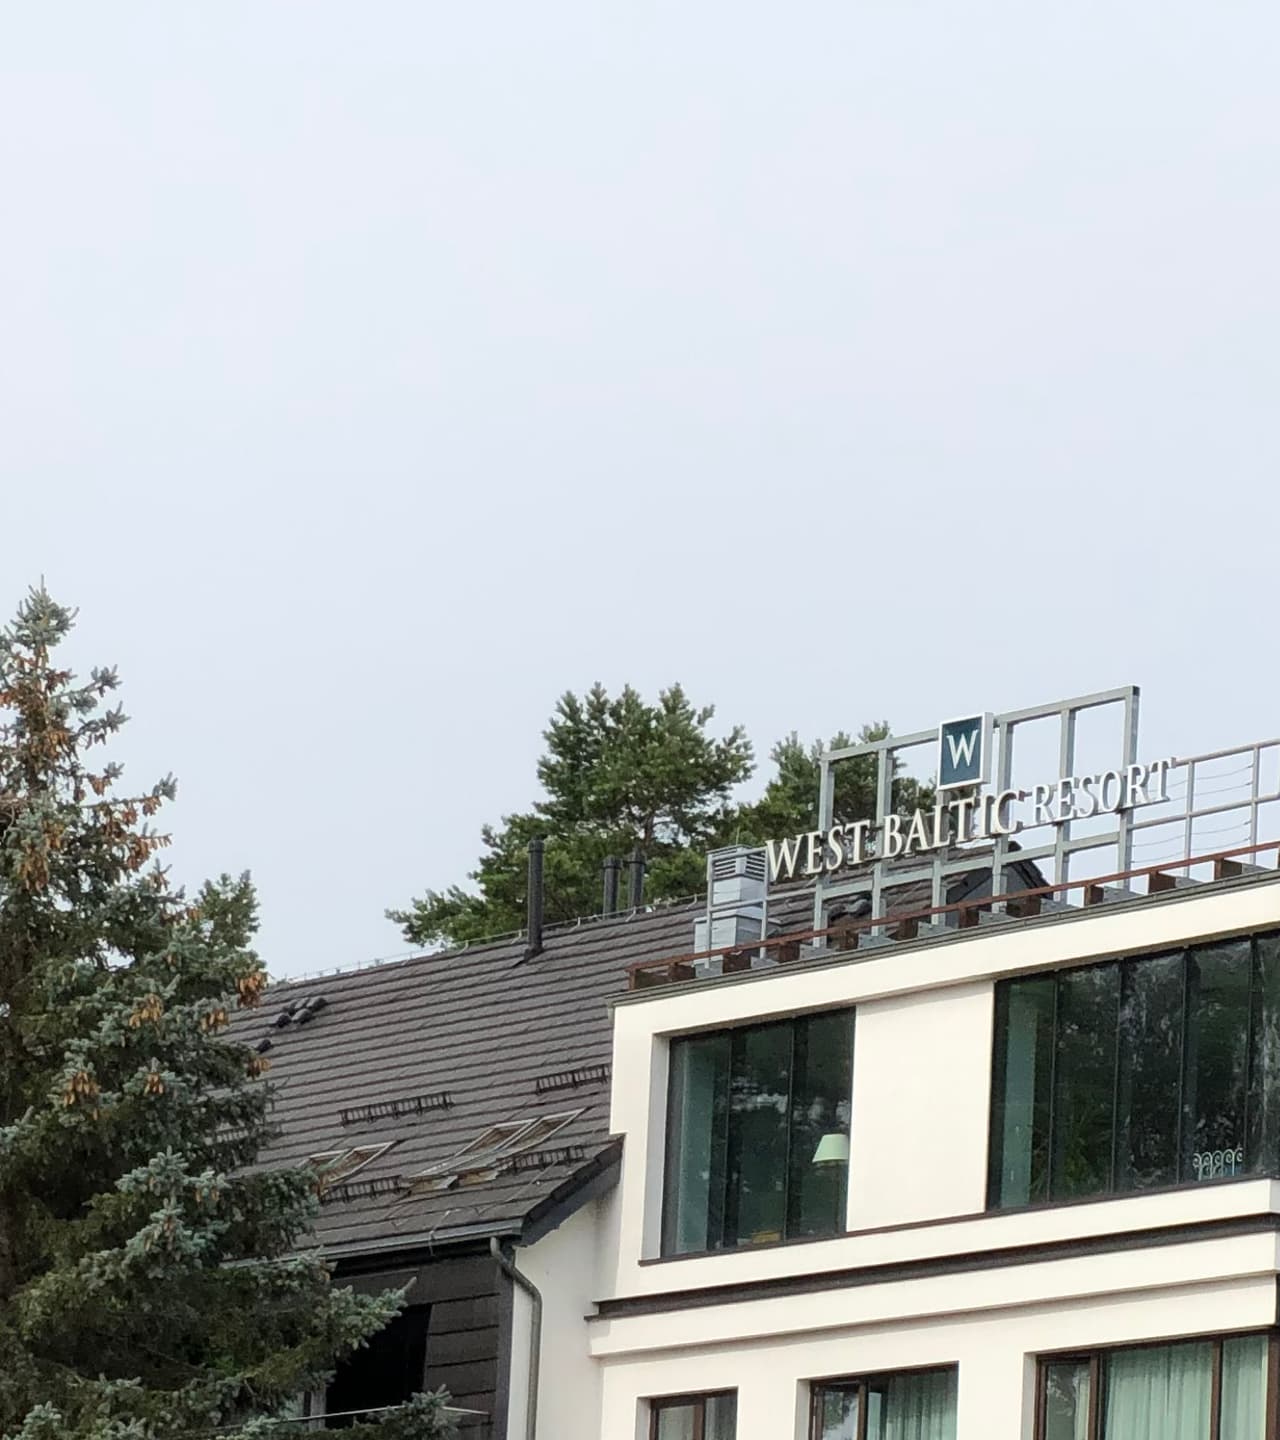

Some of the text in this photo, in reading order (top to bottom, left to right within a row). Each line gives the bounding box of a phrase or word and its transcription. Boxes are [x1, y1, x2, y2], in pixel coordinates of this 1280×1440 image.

[946, 729, 980, 769] W
[765, 758, 1175, 882] WEST BALTIC RESORT
